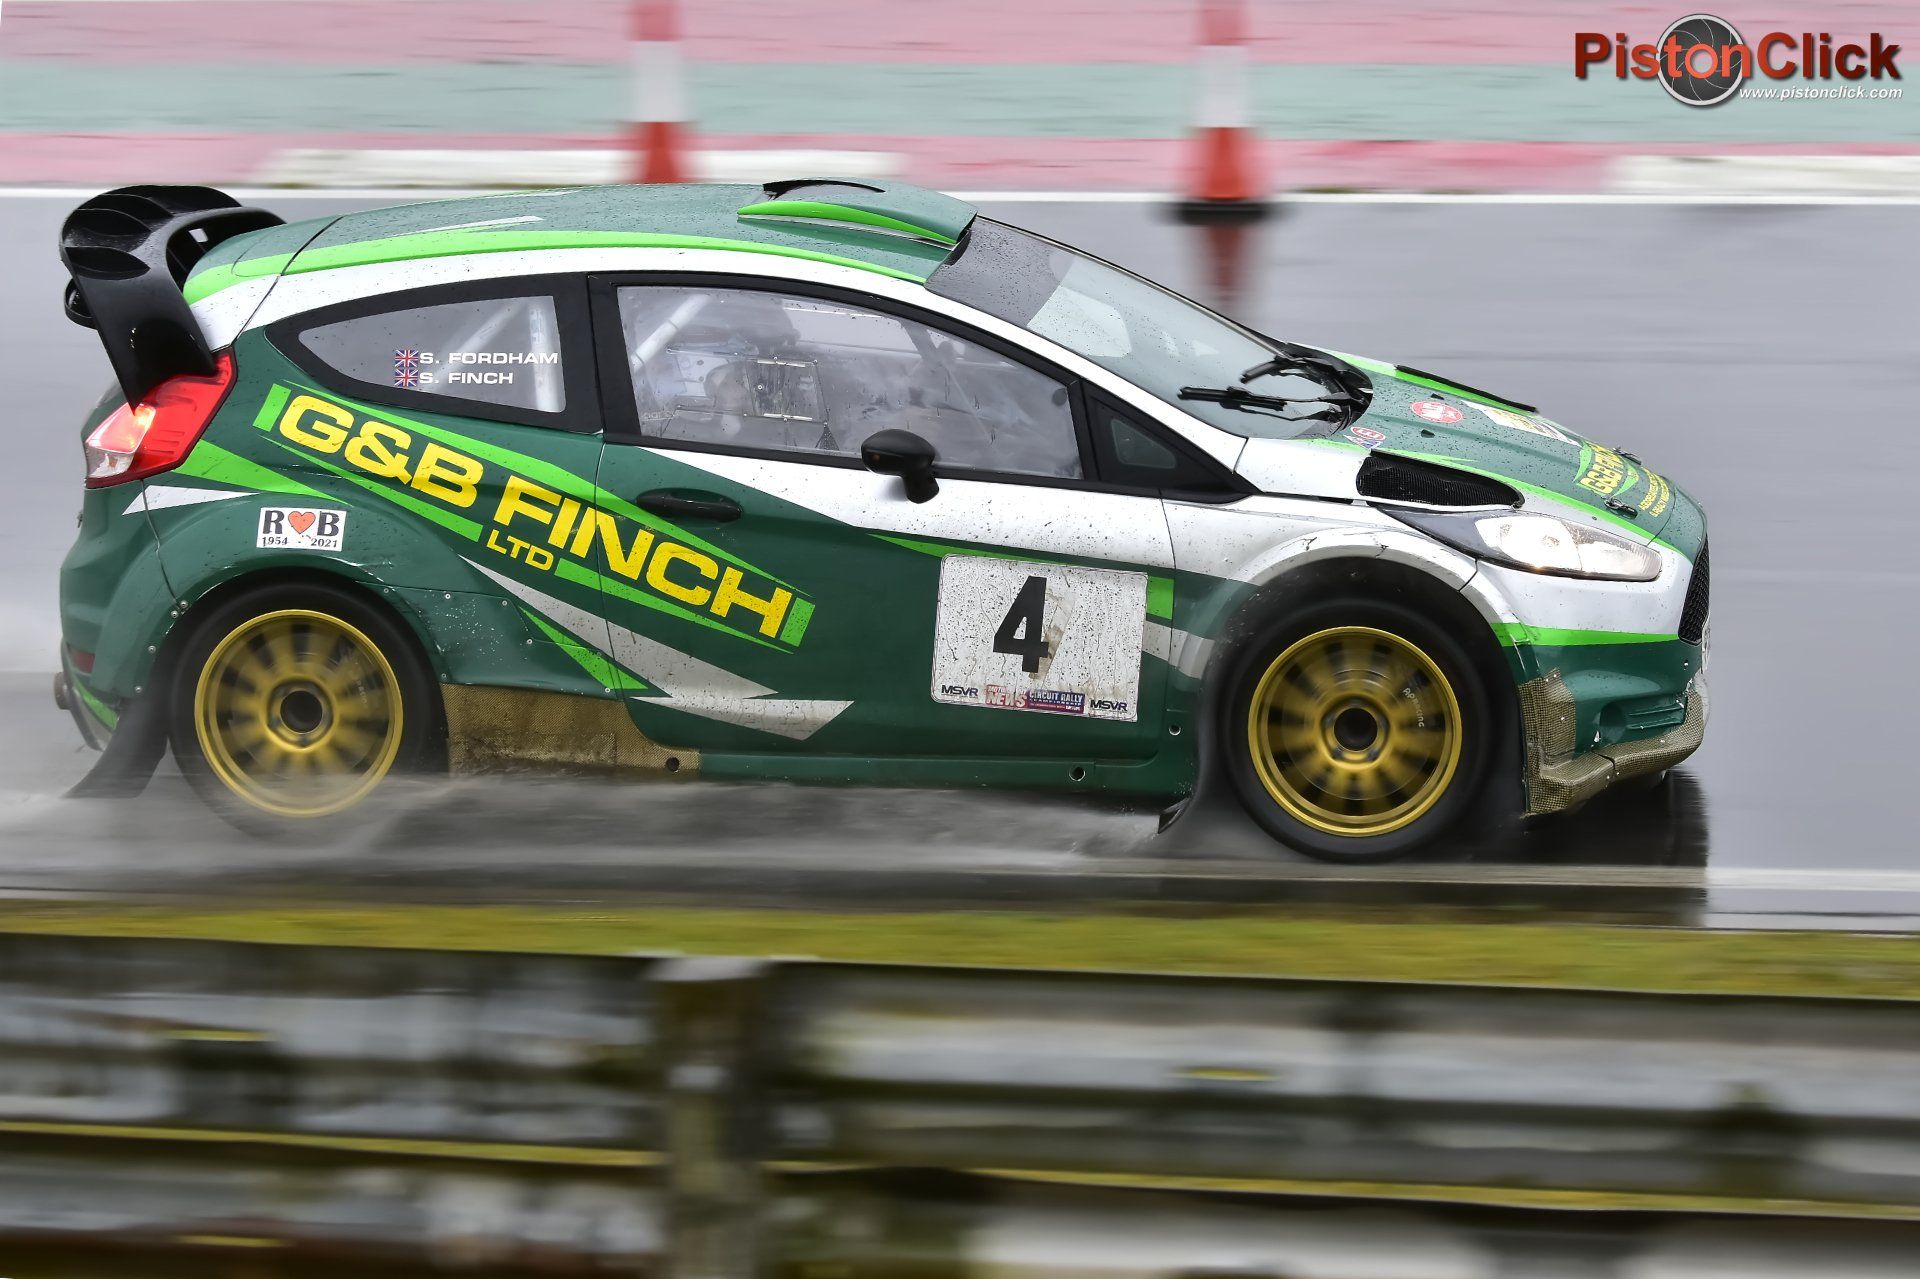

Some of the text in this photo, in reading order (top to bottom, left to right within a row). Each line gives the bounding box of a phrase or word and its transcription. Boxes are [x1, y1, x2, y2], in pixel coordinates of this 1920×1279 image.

[419, 352, 558, 364] S. FORDHAM
[419, 372, 514, 384] S. FINCH
[281, 395, 792, 637] G&B FINCH
[262, 510, 340, 537] R B
[262, 536, 288, 547] 1954
[310, 537, 338, 548] 2021
[487, 530, 554, 571] LTD
[992, 576, 1049, 673] 4
[941, 685, 979, 697] MSVR
[1029, 690, 1083, 703] CIRCUIT RALLY
[986, 691, 1028, 708] NEWS
[1090, 699, 1128, 711] MSVR
